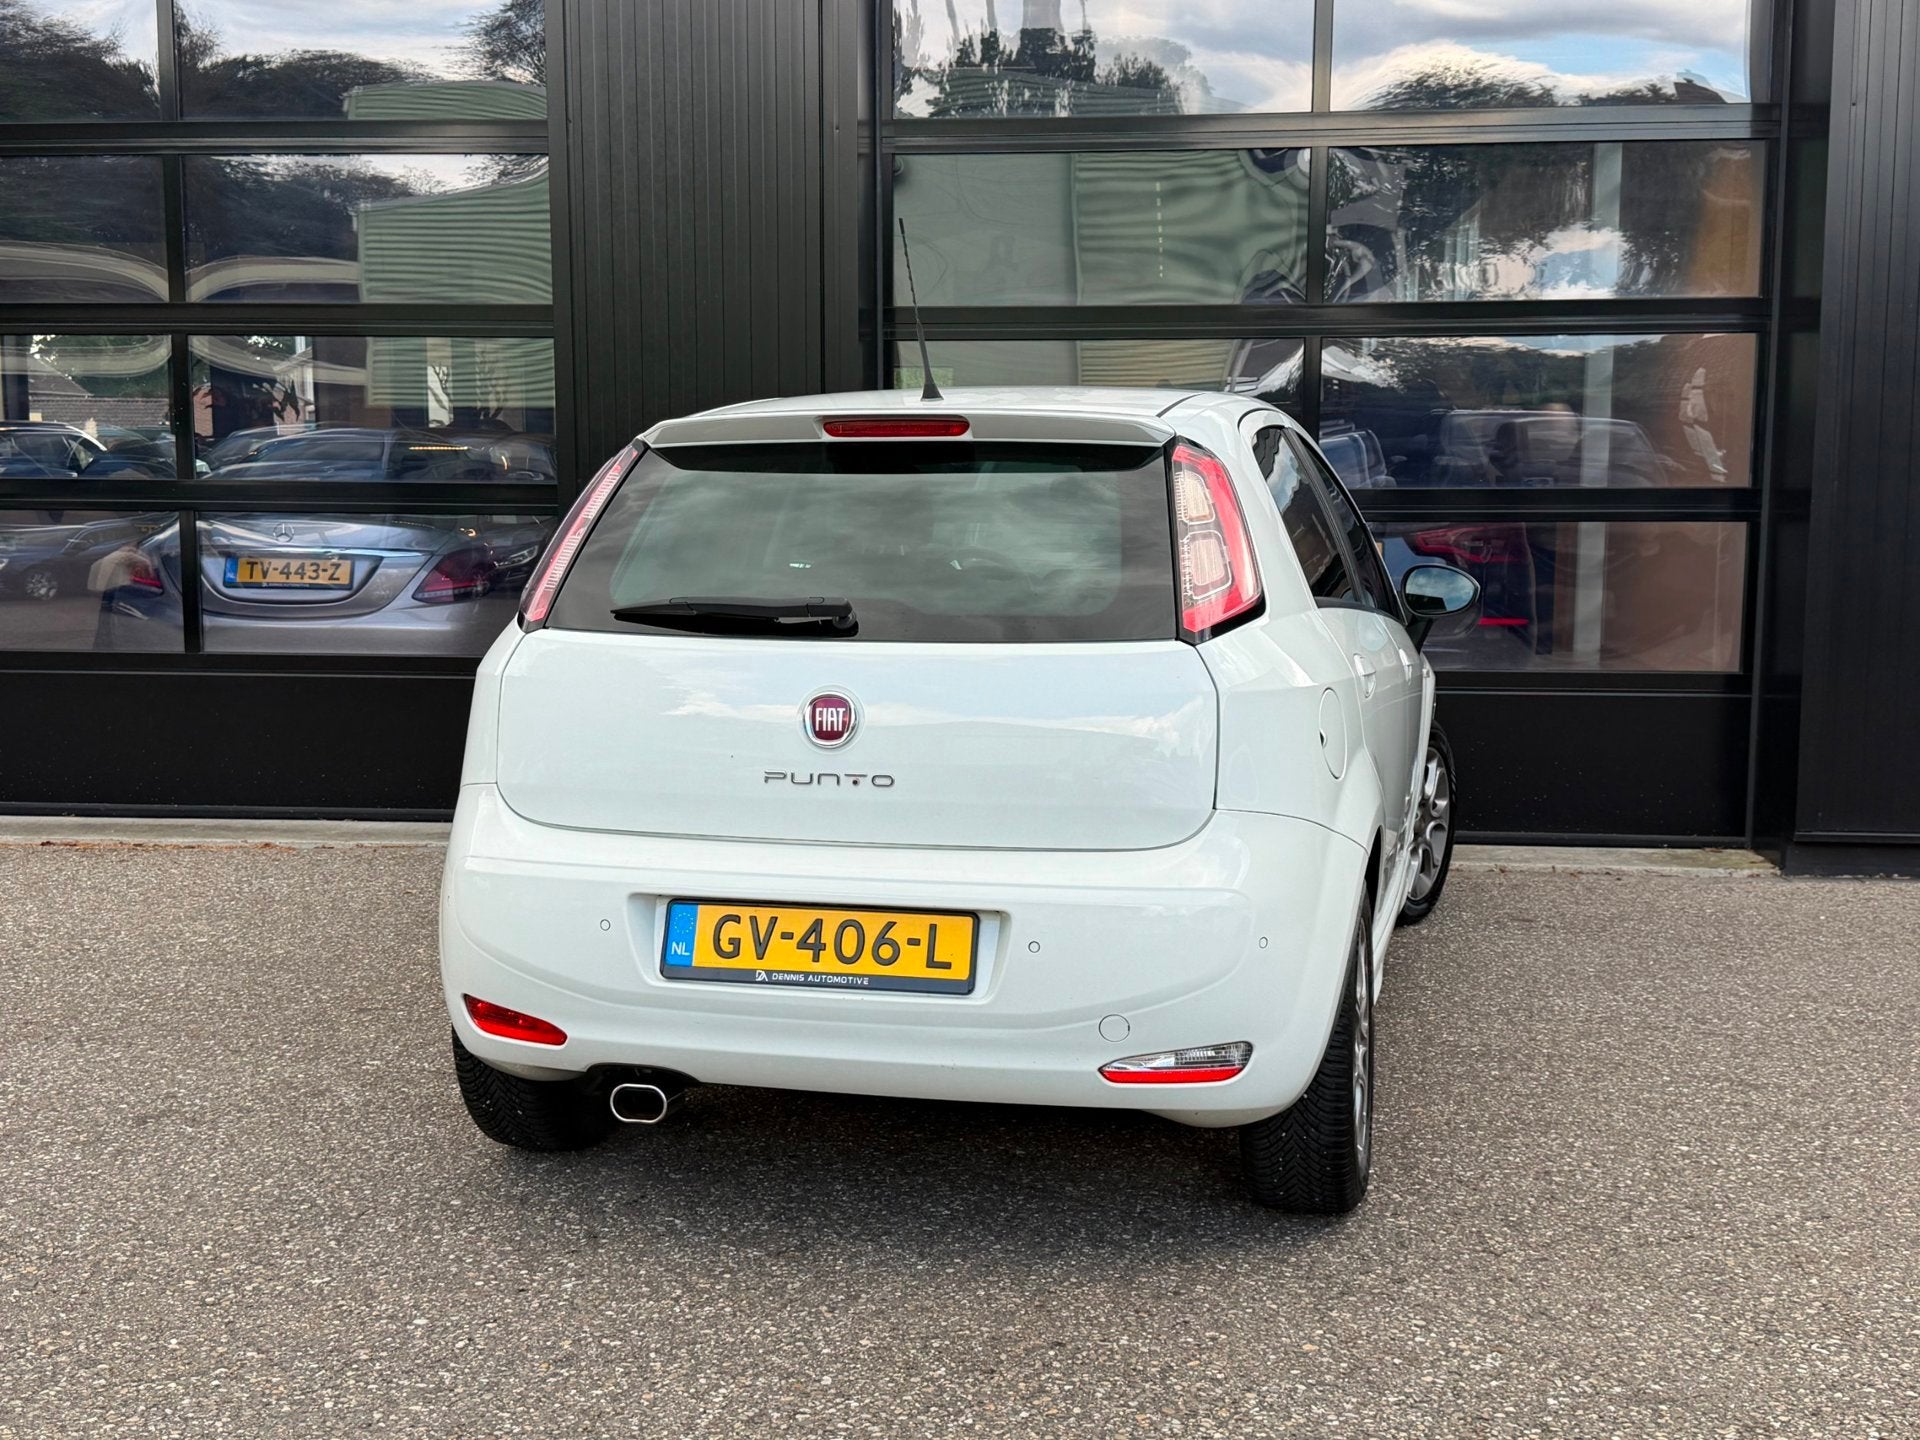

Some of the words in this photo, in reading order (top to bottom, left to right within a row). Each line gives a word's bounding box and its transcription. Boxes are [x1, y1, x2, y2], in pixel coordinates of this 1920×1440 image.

[246, 561, 342, 581] TV-443-Z
[815, 707, 846, 732] FIAT
[763, 771, 895, 788] PUNTO
[671, 941, 690, 956] NL
[712, 914, 953, 970] GV-406-L
[772, 972, 804, 982] DENNIS
[807, 974, 870, 985] AUTOMOTIVE
